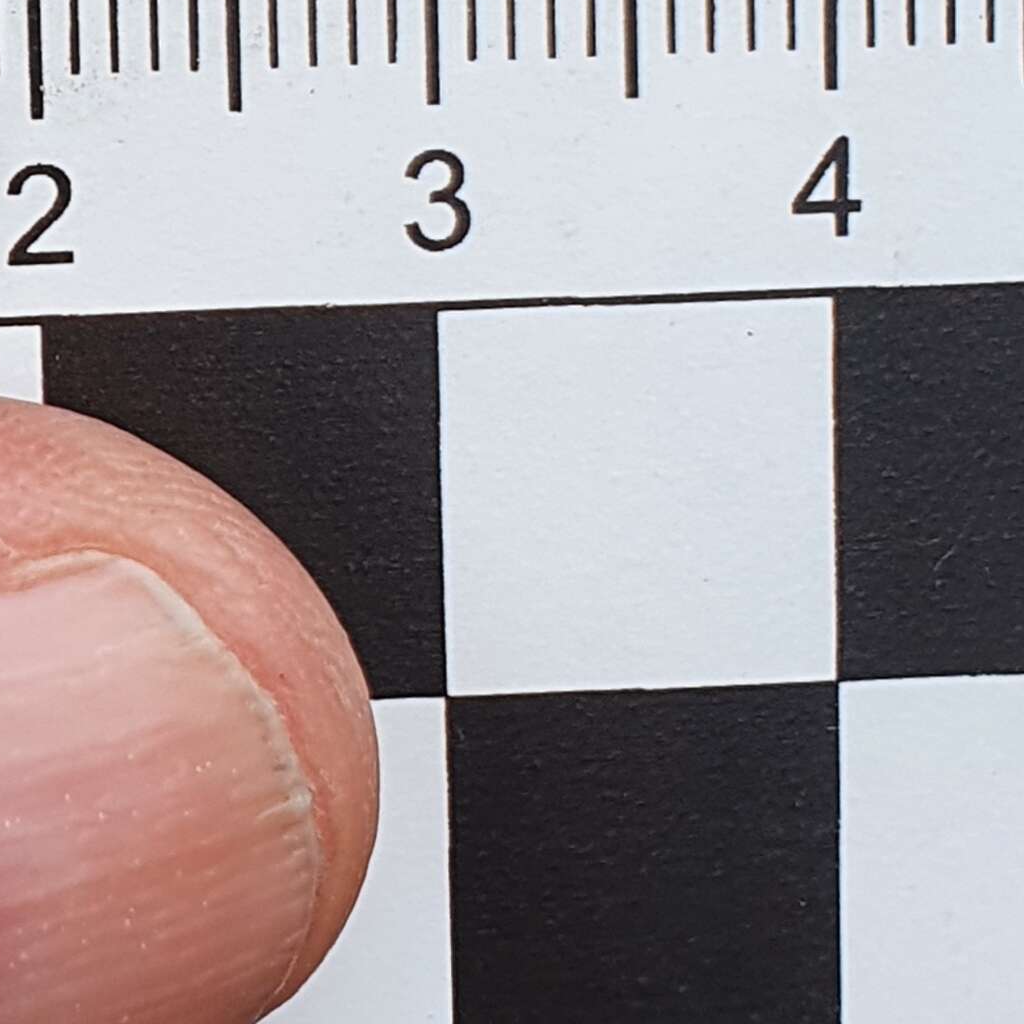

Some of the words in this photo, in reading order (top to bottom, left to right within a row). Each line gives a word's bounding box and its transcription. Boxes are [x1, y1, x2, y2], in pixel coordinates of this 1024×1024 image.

[7, 163, 74, 266] 2
[405, 149, 471, 252] 3
[792, 135, 862, 237] 4
